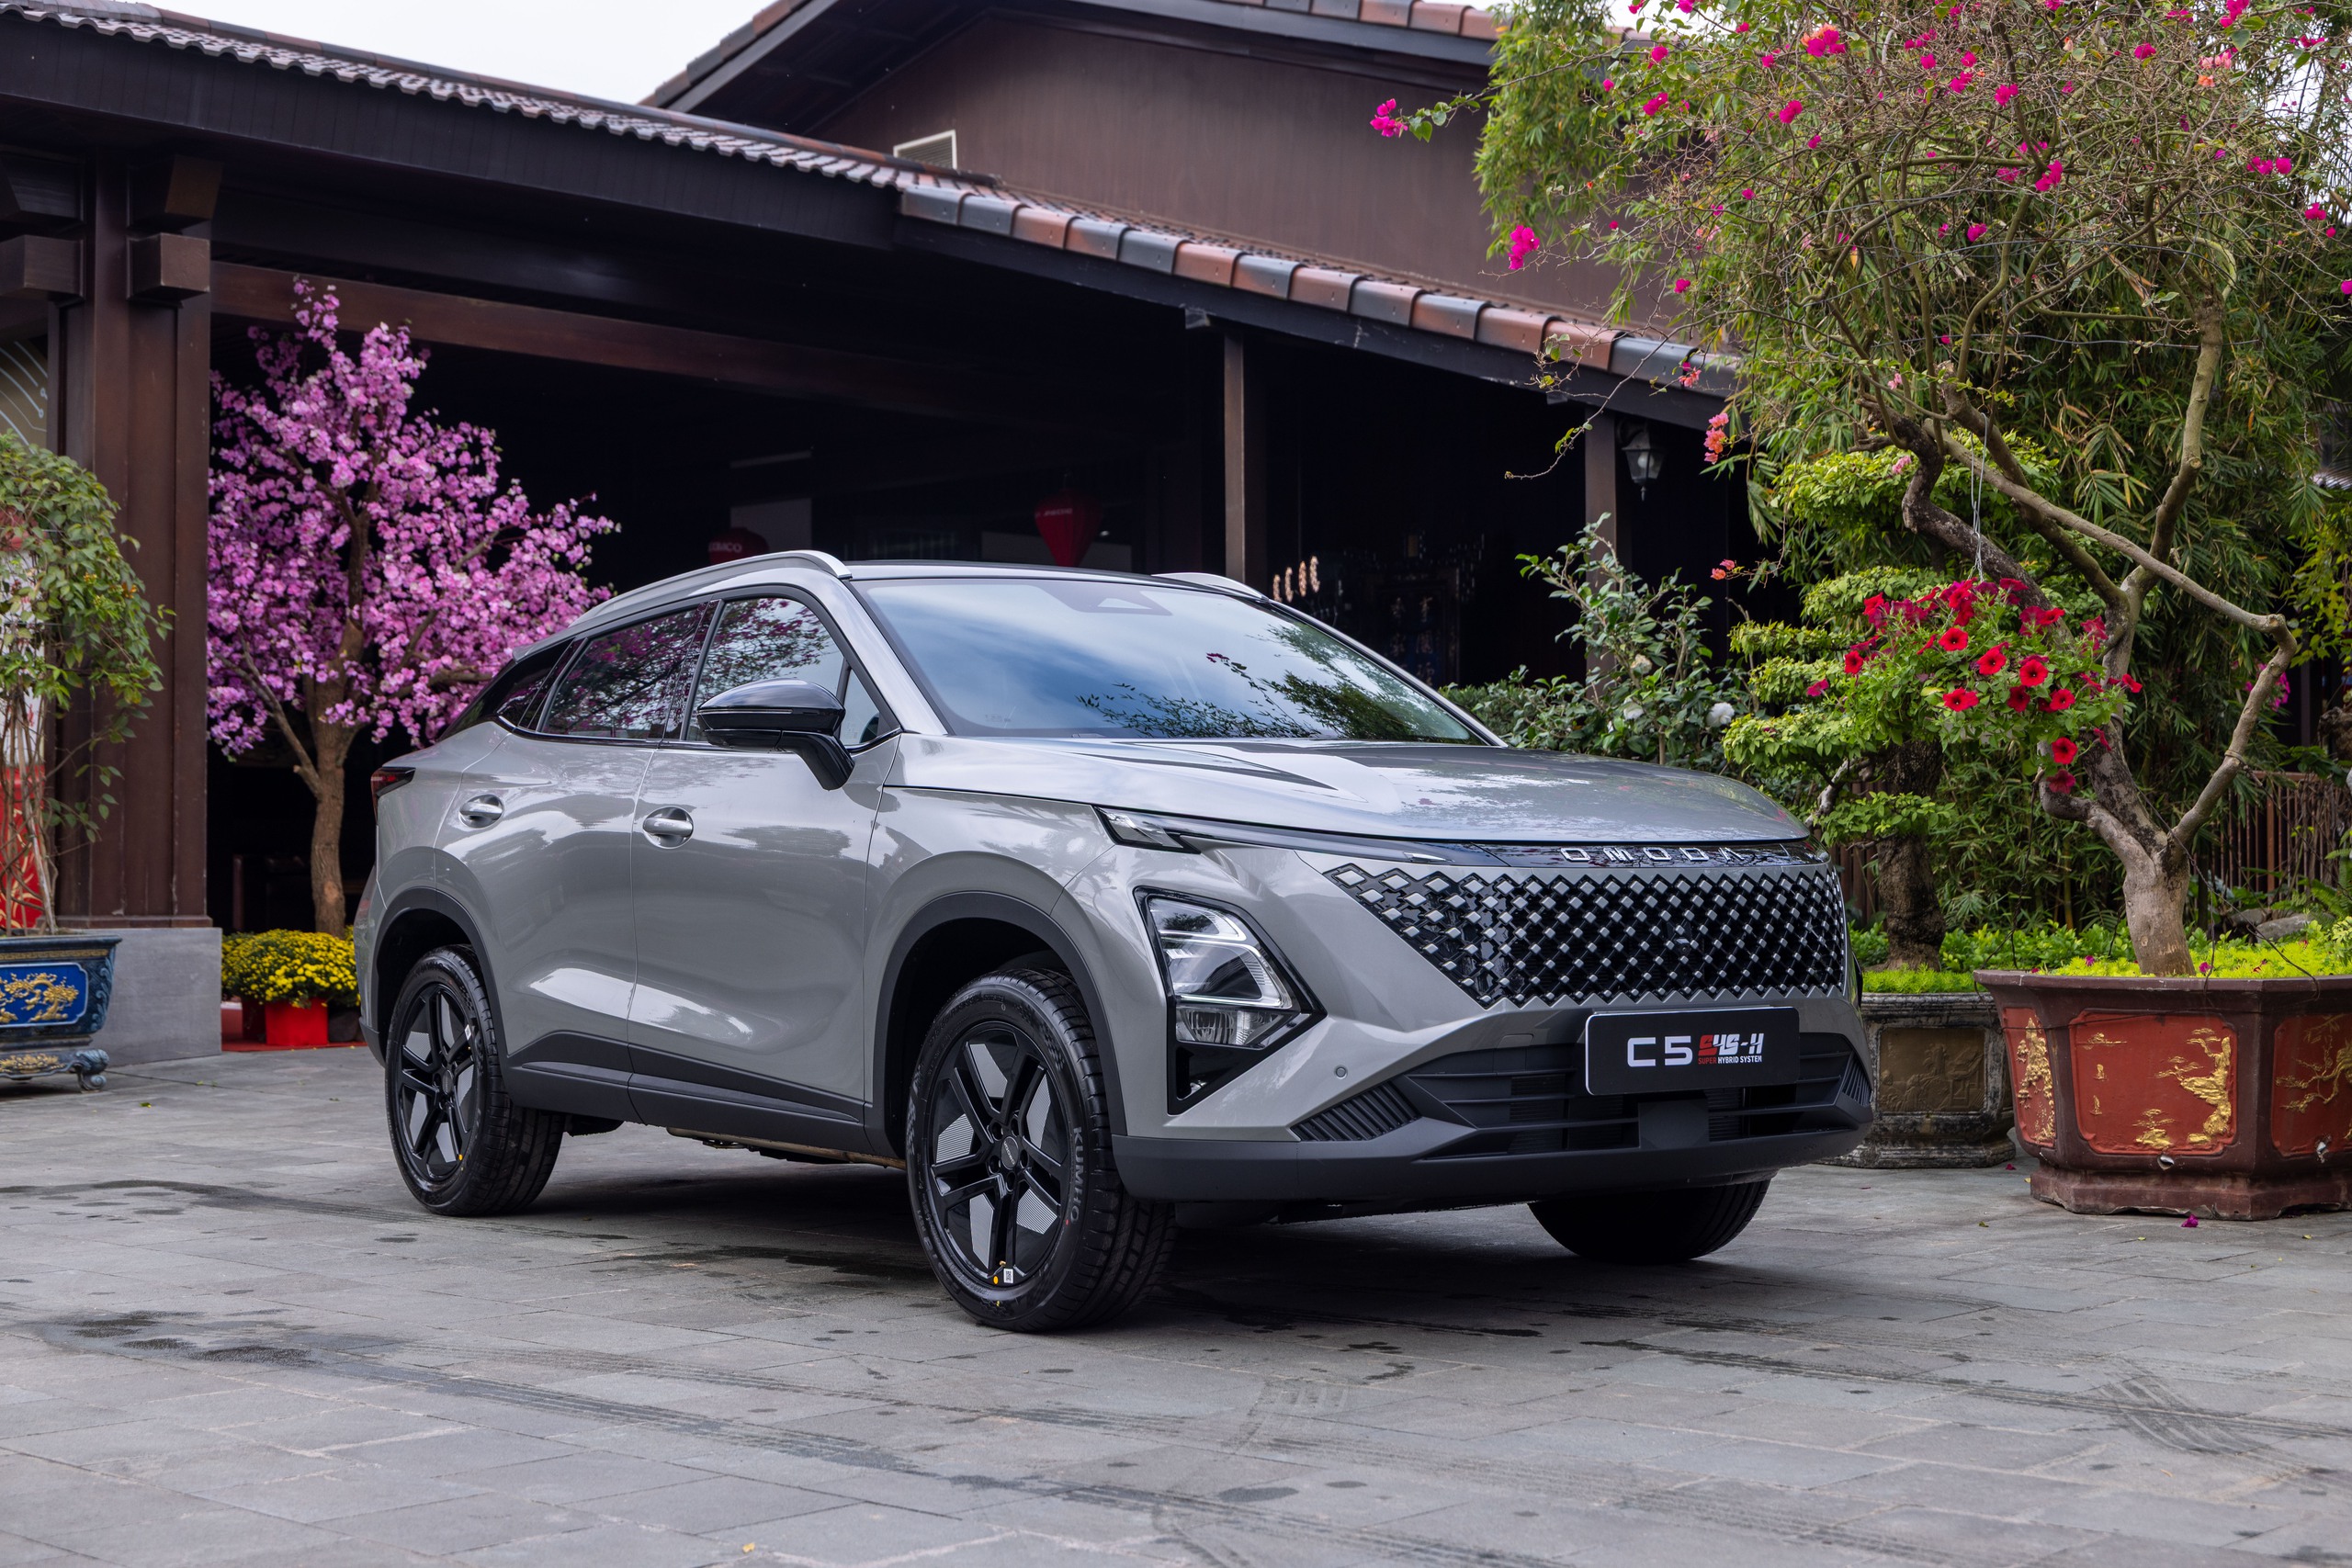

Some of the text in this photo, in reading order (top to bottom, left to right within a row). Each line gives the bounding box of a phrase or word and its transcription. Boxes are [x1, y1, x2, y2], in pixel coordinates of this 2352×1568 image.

[1561, 846, 1746, 863] OMODA
[1627, 1036, 1693, 1067] C5
[1698, 1055, 1762, 1065] SUPER HYBRID SYSTEM
[1070, 1126, 1084, 1224] KUMHO
